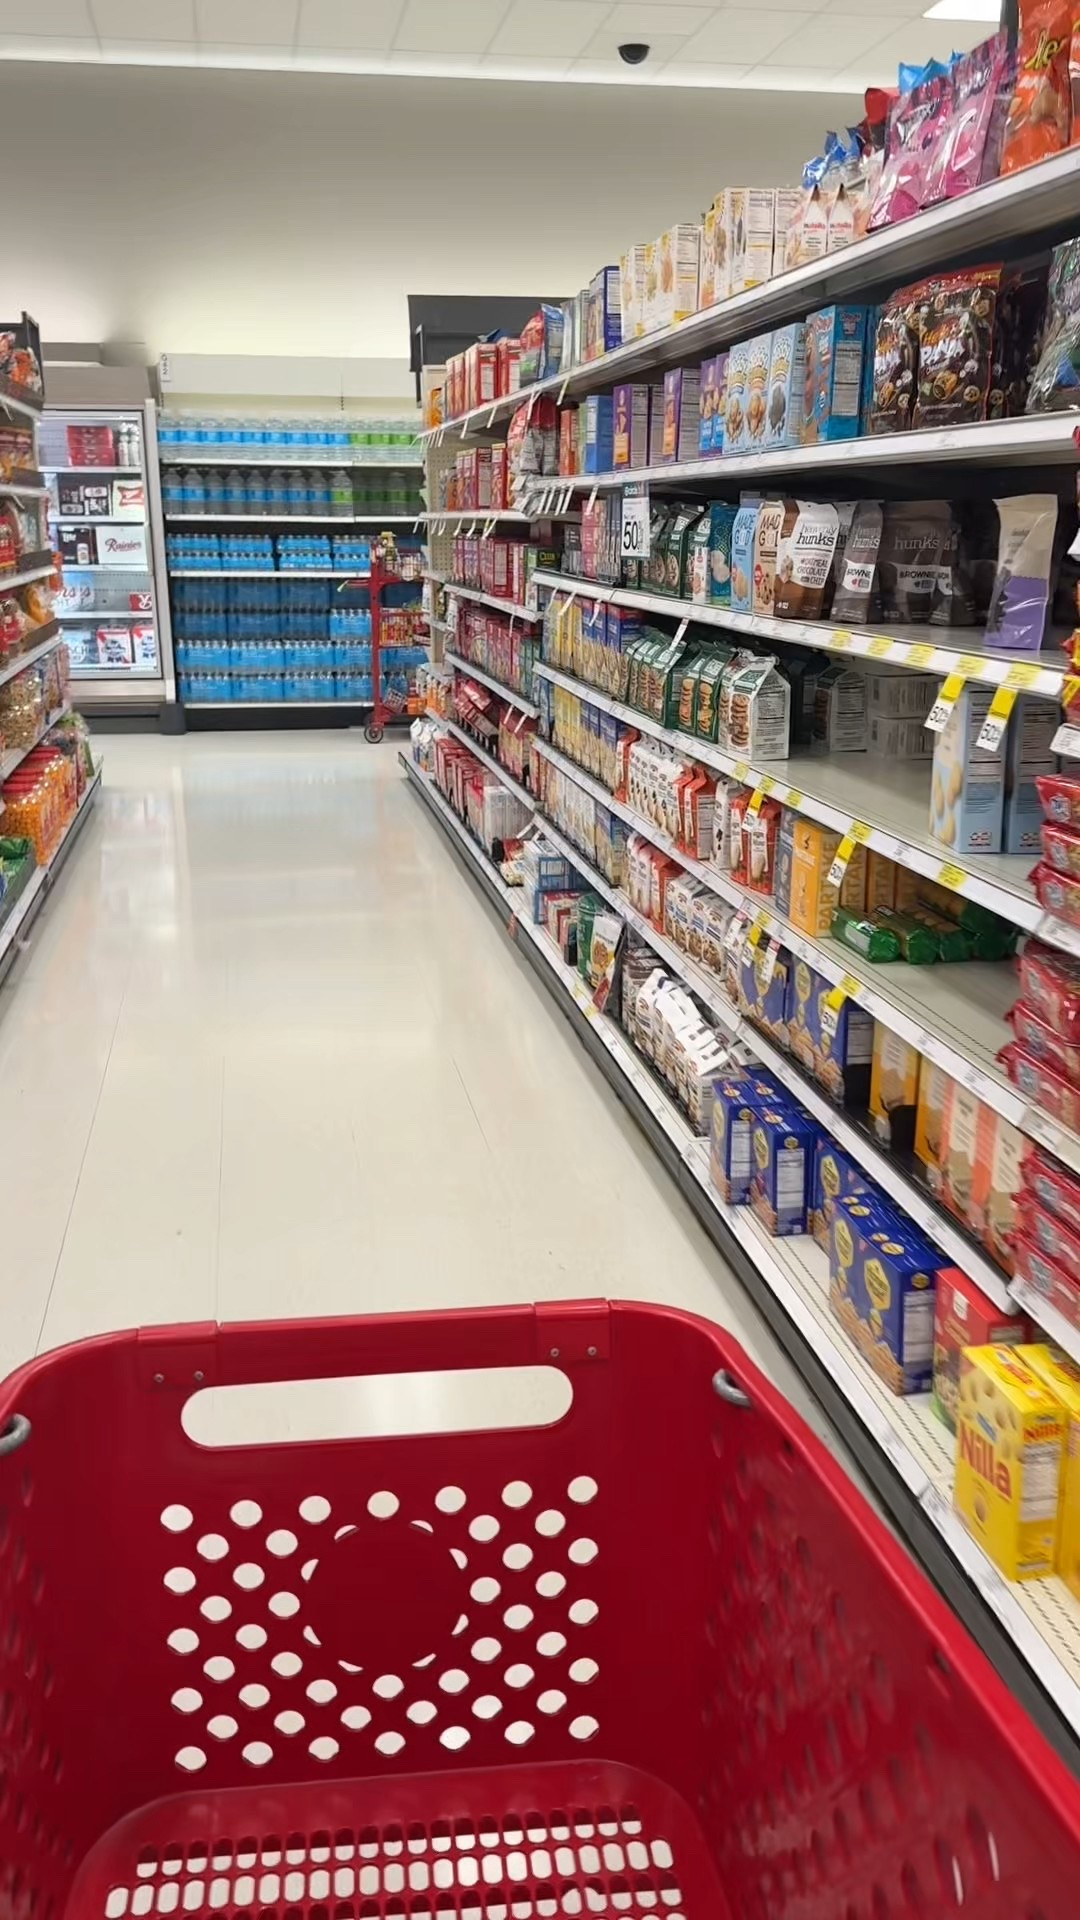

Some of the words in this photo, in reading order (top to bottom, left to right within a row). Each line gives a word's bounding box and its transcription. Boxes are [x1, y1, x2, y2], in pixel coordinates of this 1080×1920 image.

[761, 515, 781, 530] MAD
[105, 538, 142, 552] Rainier
[797, 532, 834, 546] hunks
[894, 536, 939, 550] hunks
[959, 1417, 1012, 1499] Nilla
